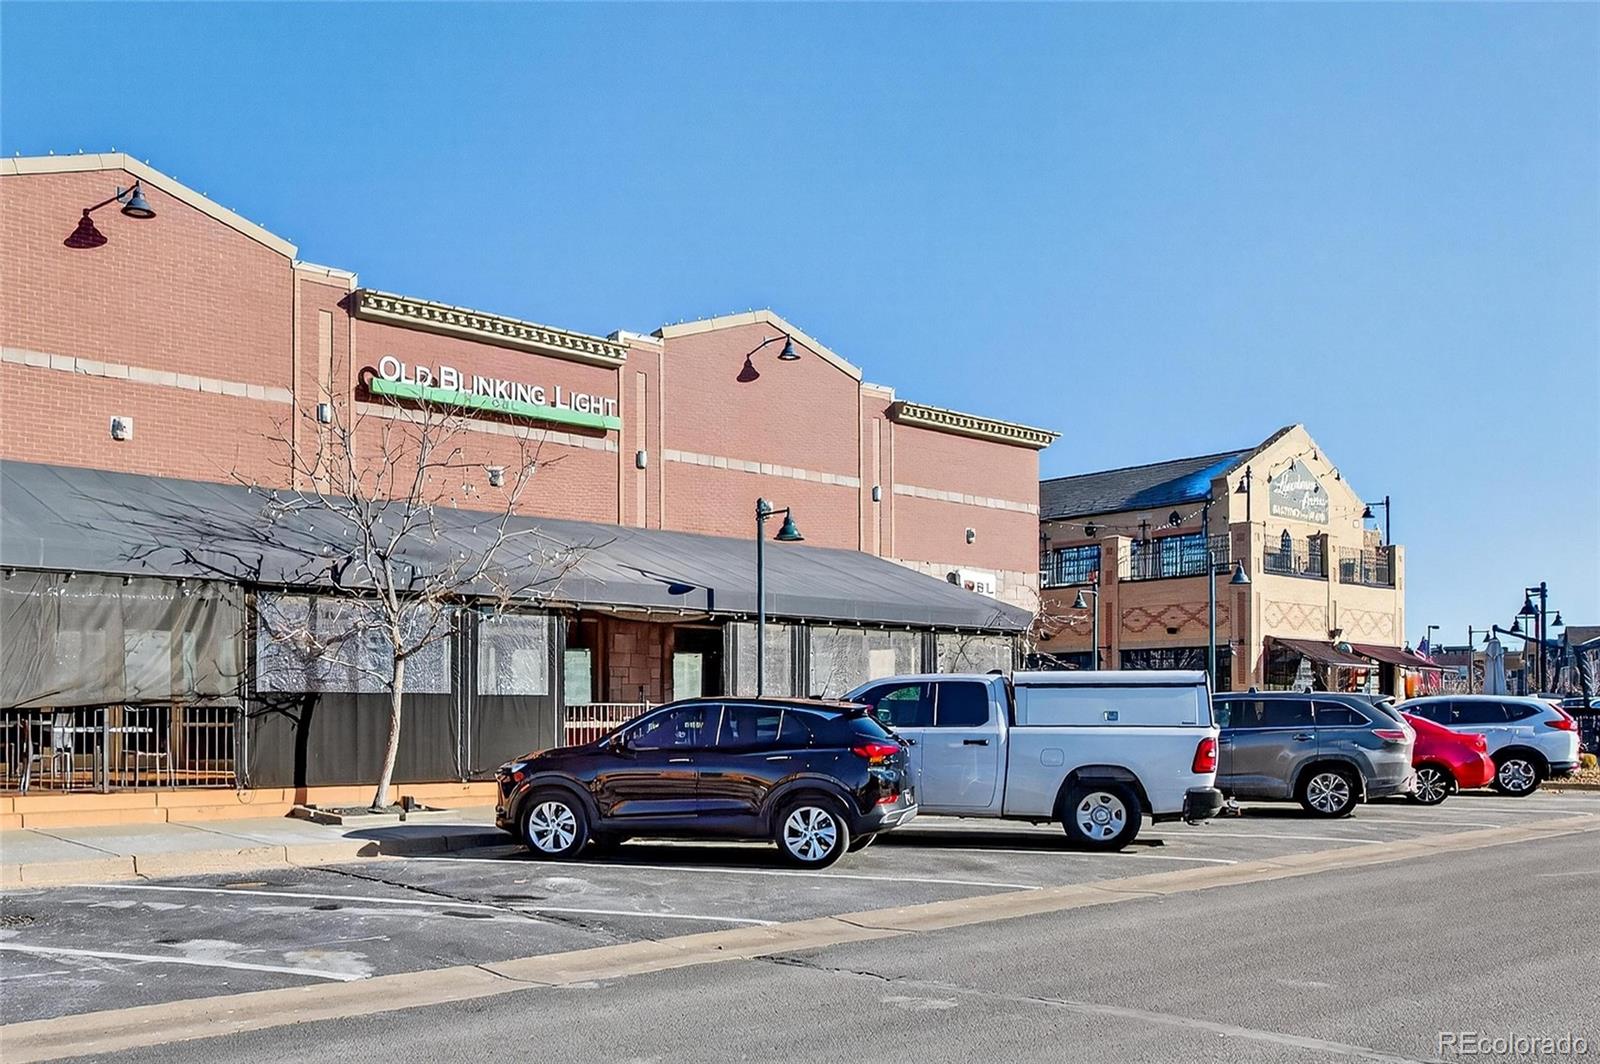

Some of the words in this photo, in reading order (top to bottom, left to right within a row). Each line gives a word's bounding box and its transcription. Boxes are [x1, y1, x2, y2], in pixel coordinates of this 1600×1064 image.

[379, 356, 431, 385] OLD
[440, 365, 546, 407] BLINKING
[556, 385, 617, 417] LIGHT
